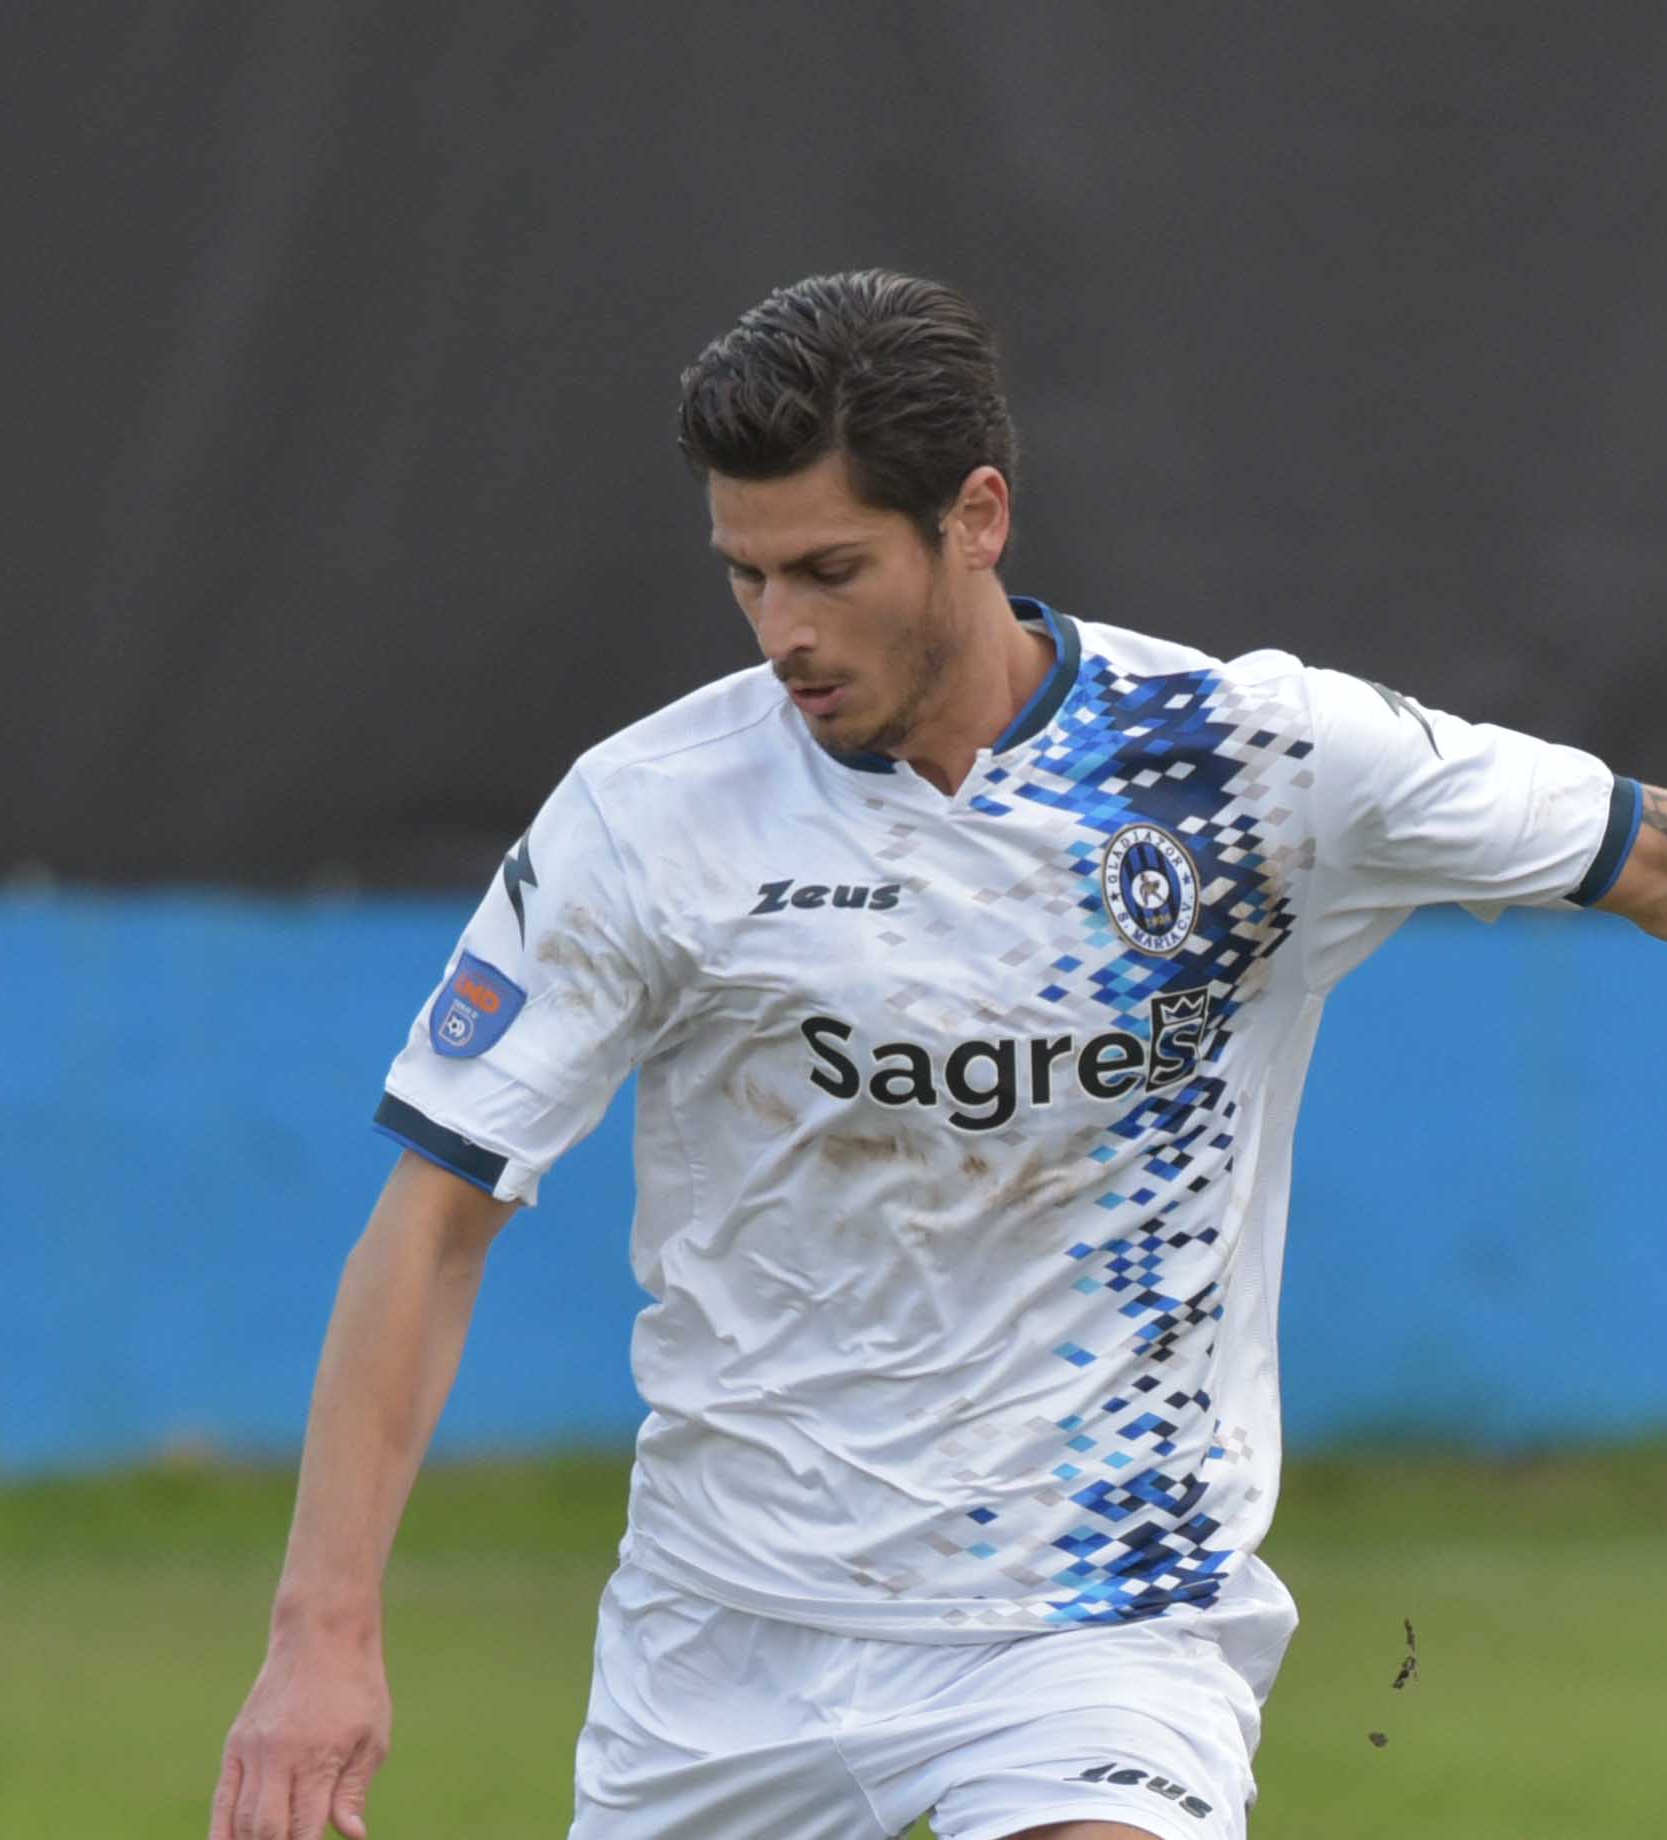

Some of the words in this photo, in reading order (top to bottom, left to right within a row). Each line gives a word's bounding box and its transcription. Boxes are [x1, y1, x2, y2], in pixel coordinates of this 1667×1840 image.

[1107, 830, 1183, 885] GLADIATOR
[749, 879, 901, 916] Zeus
[800, 1012, 1205, 1132] Sagres
